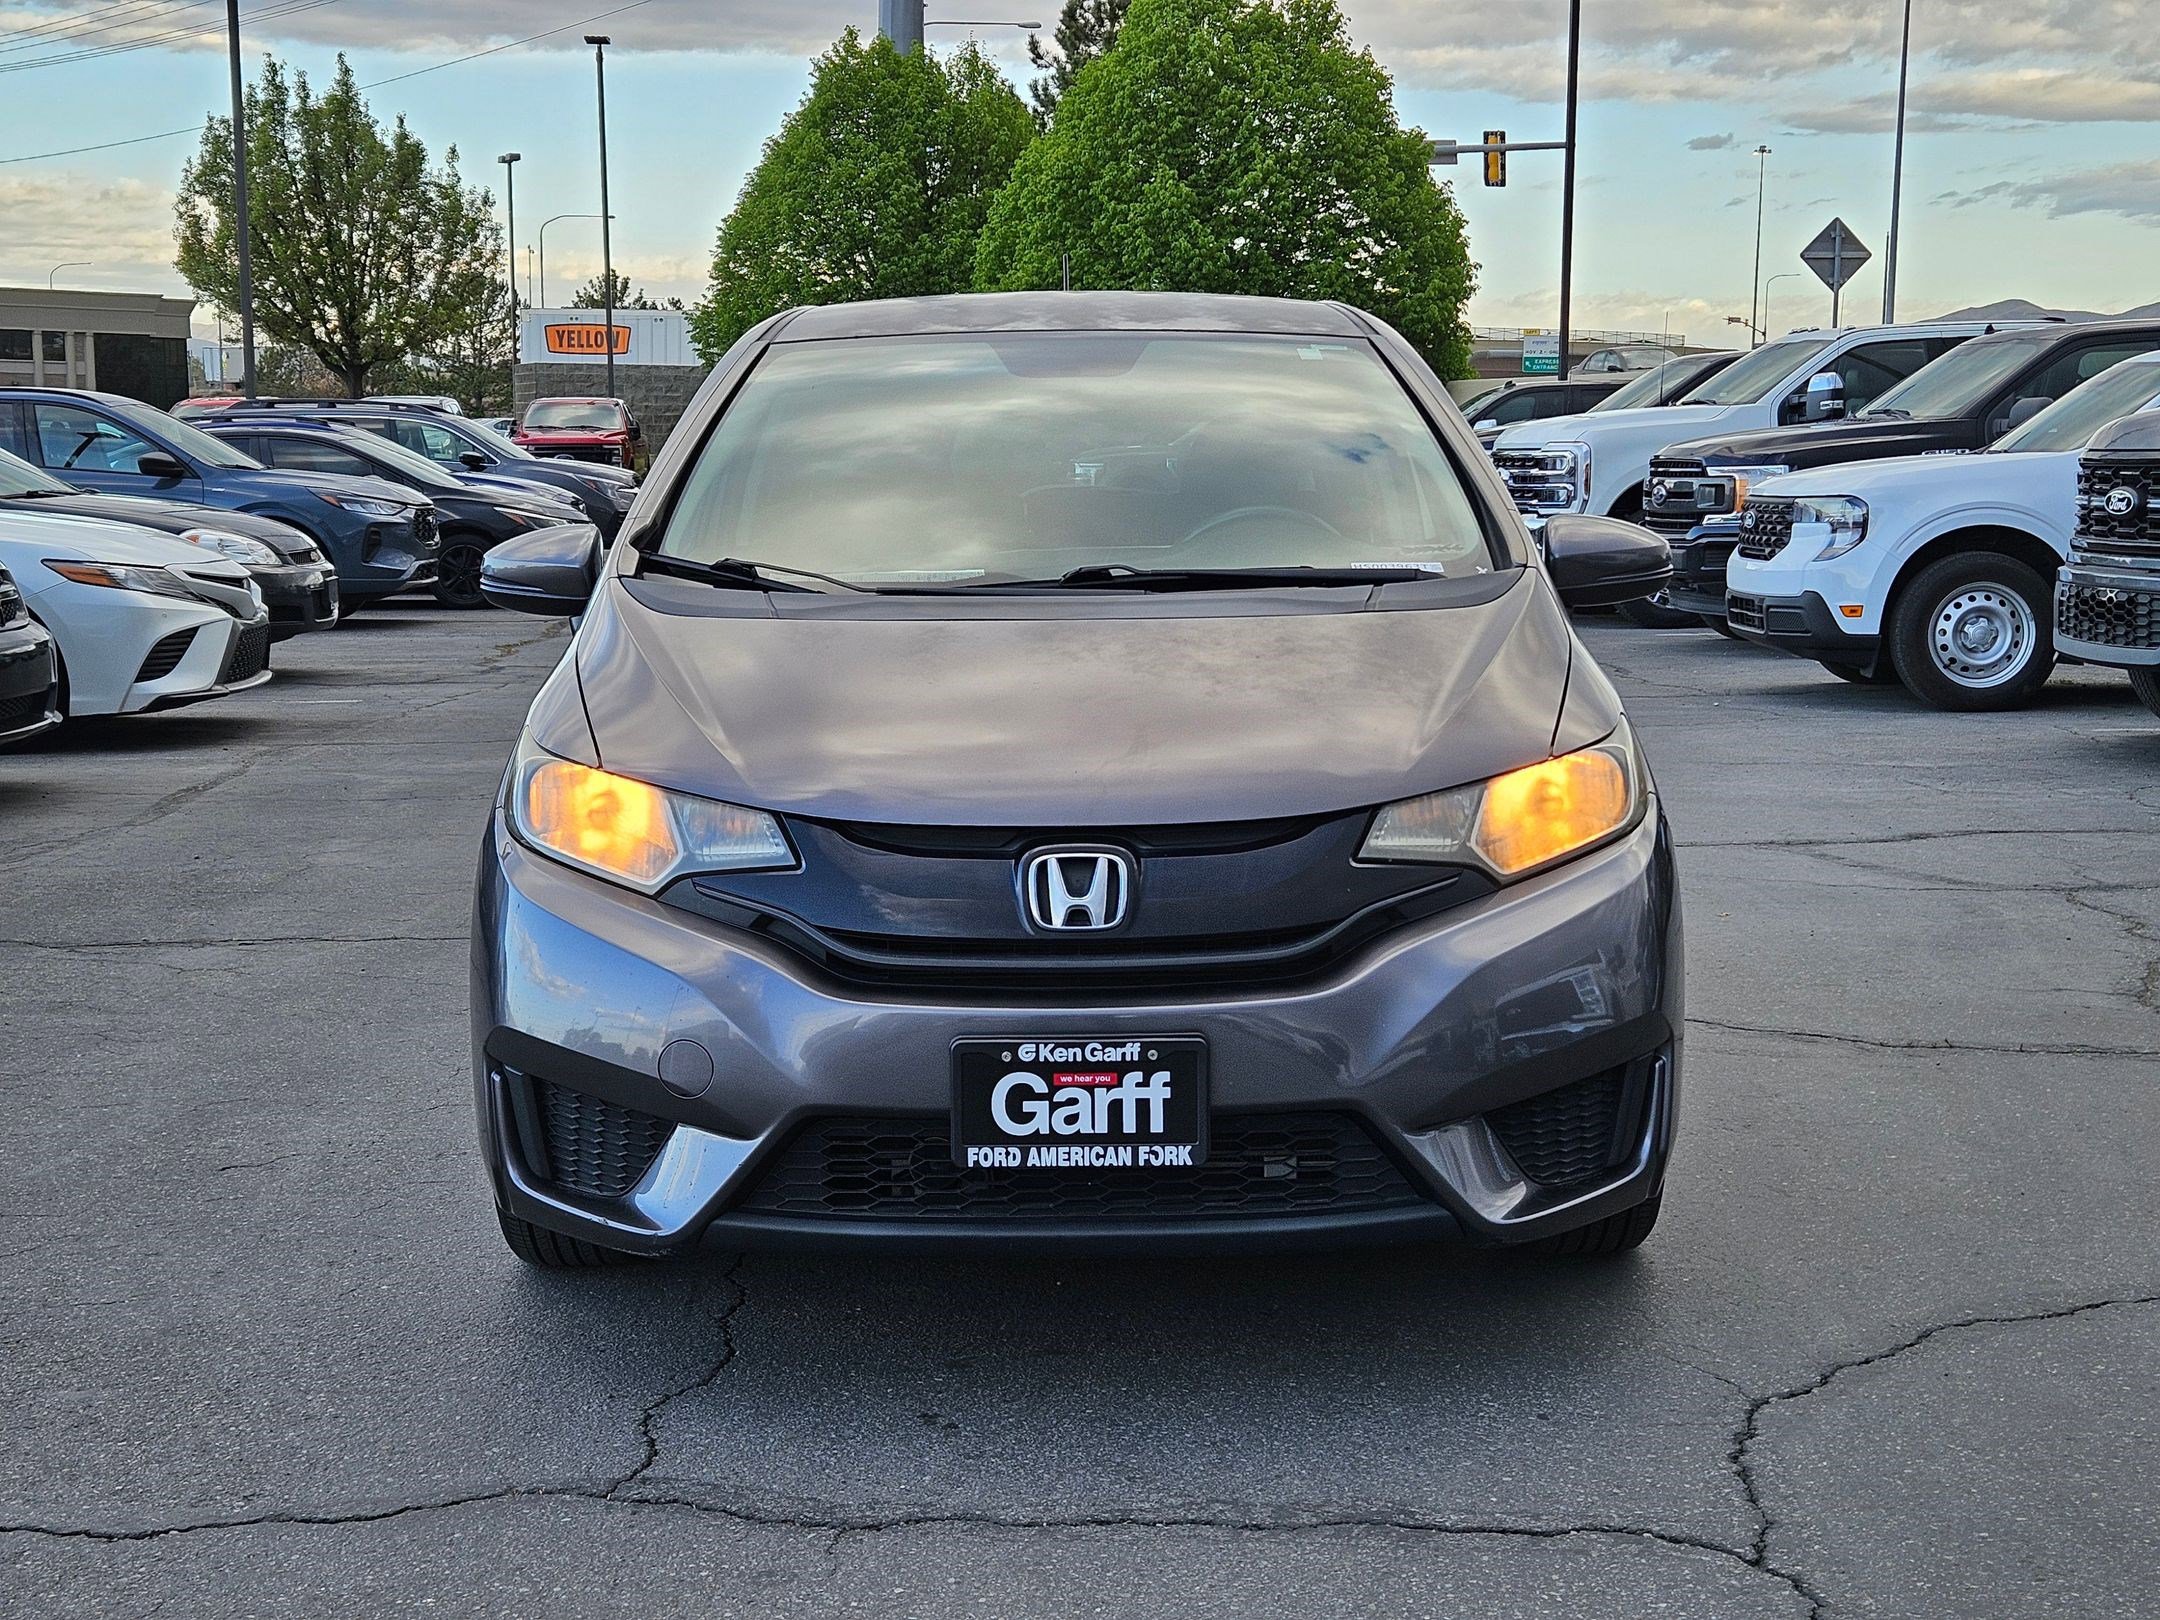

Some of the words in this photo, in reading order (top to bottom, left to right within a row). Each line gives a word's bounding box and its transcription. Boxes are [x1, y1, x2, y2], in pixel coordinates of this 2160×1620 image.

[1039, 1043, 1082, 1062] Ken
[1084, 1042, 1141, 1062] Garff
[1060, 1075, 1073, 1083] we
[1074, 1073, 1094, 1083] hear
[1094, 1075, 1111, 1085] you
[991, 1071, 1172, 1136] Garff
[967, 1146, 1022, 1167] FORD
[1027, 1146, 1134, 1167] AMERICAN
[1138, 1145, 1194, 1167] FORK
